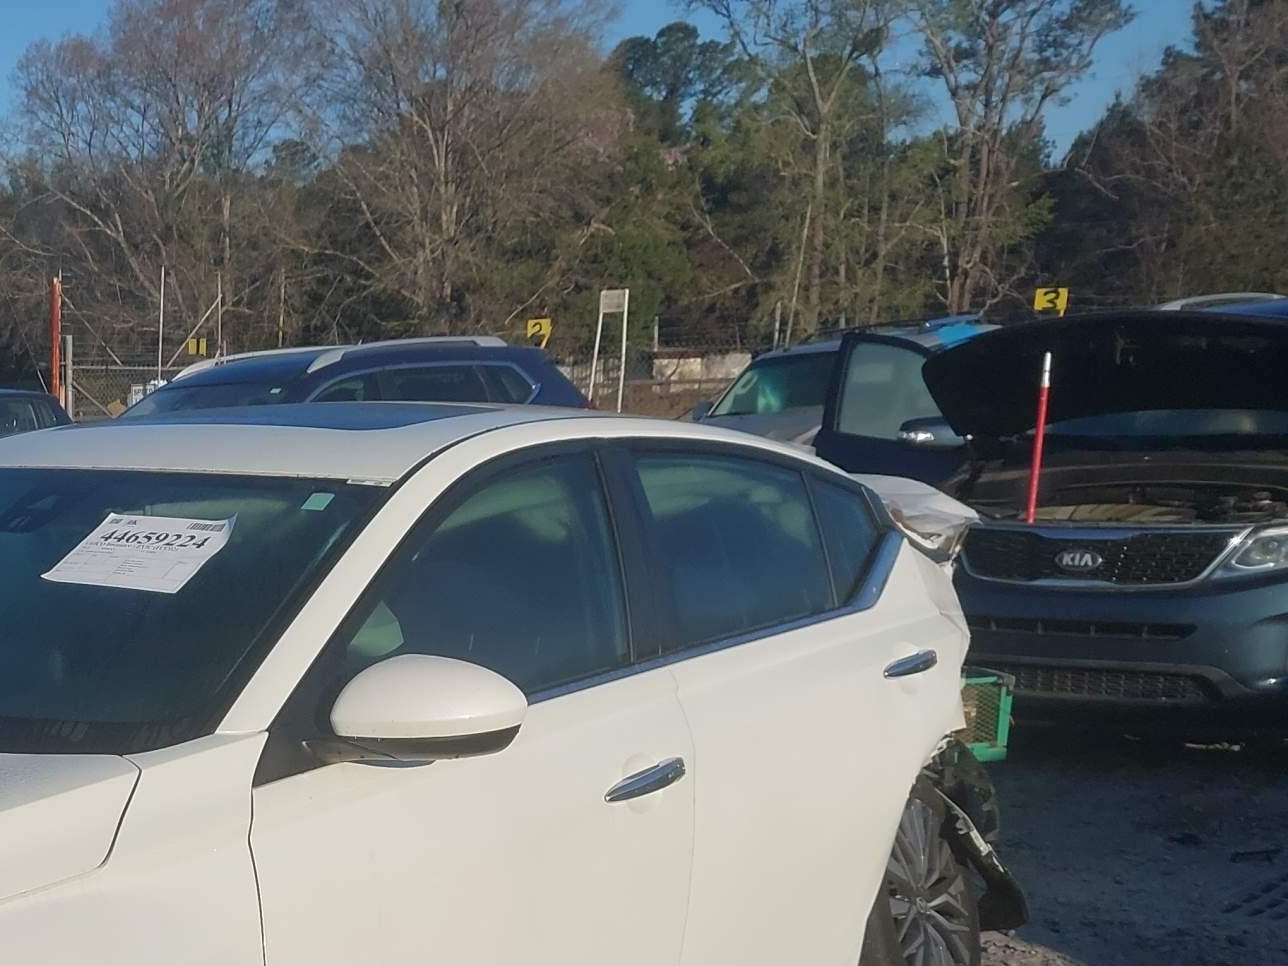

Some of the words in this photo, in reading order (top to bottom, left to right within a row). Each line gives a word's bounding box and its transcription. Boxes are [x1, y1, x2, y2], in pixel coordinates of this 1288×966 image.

[1042, 290, 1060, 310] 3
[100, 529, 209, 549] 44659224
[1062, 553, 1093, 567] KIA
